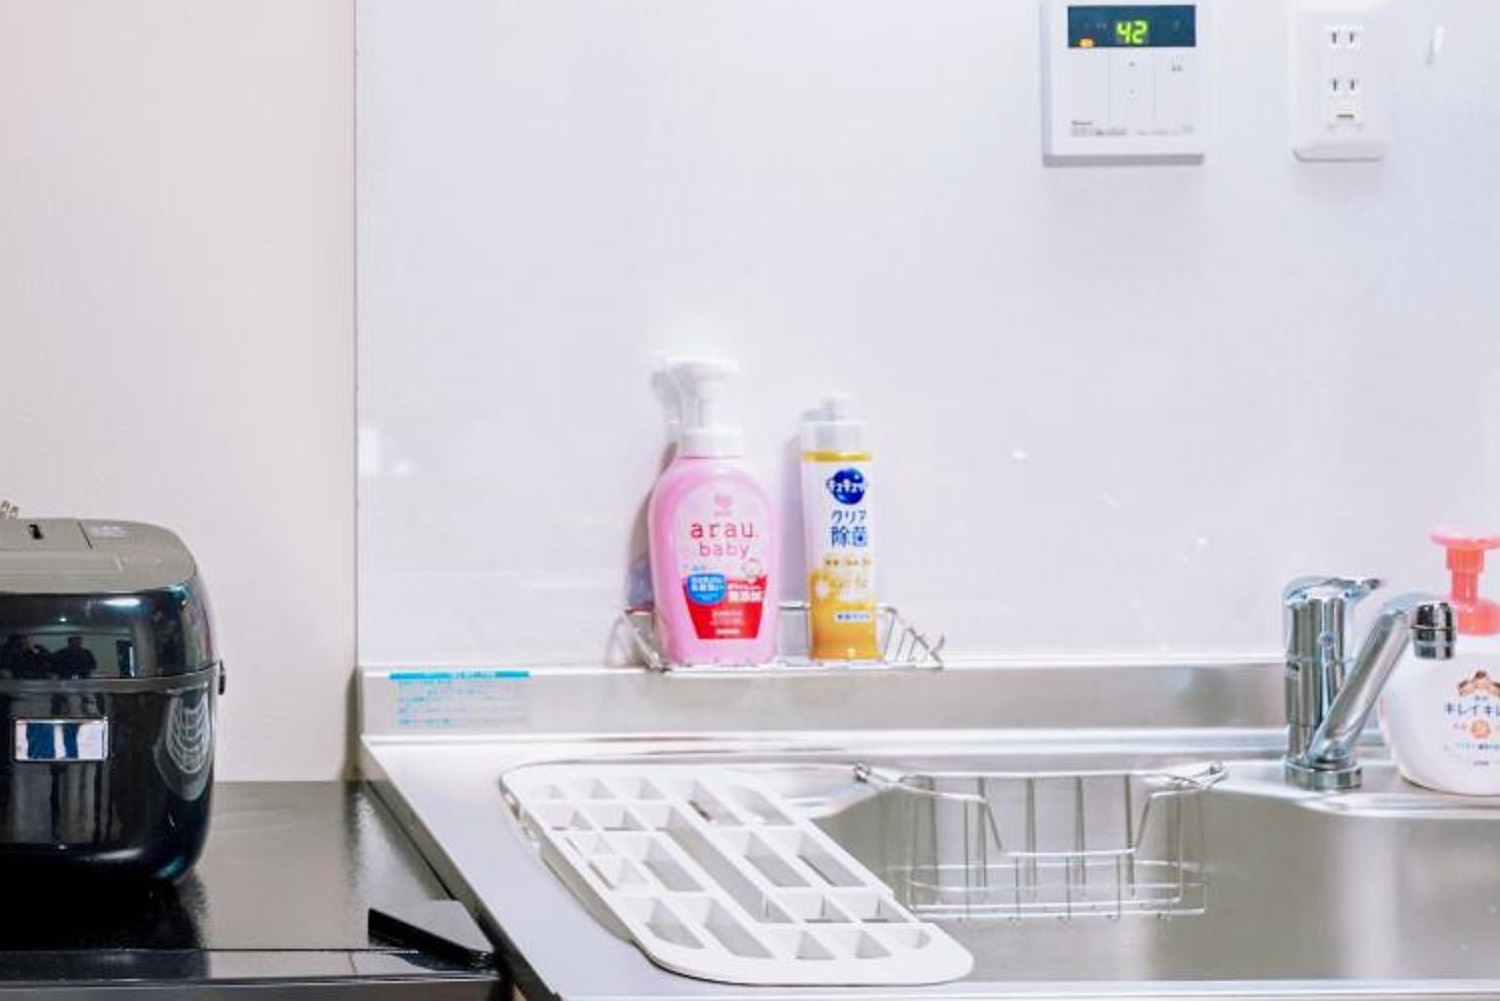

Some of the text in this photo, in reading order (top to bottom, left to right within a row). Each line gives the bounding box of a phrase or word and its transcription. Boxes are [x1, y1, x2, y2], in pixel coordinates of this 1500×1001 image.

[1117, 20, 1148, 44] 42
[831, 525, 869, 548] 除菌
[699, 542, 750, 559] baby
